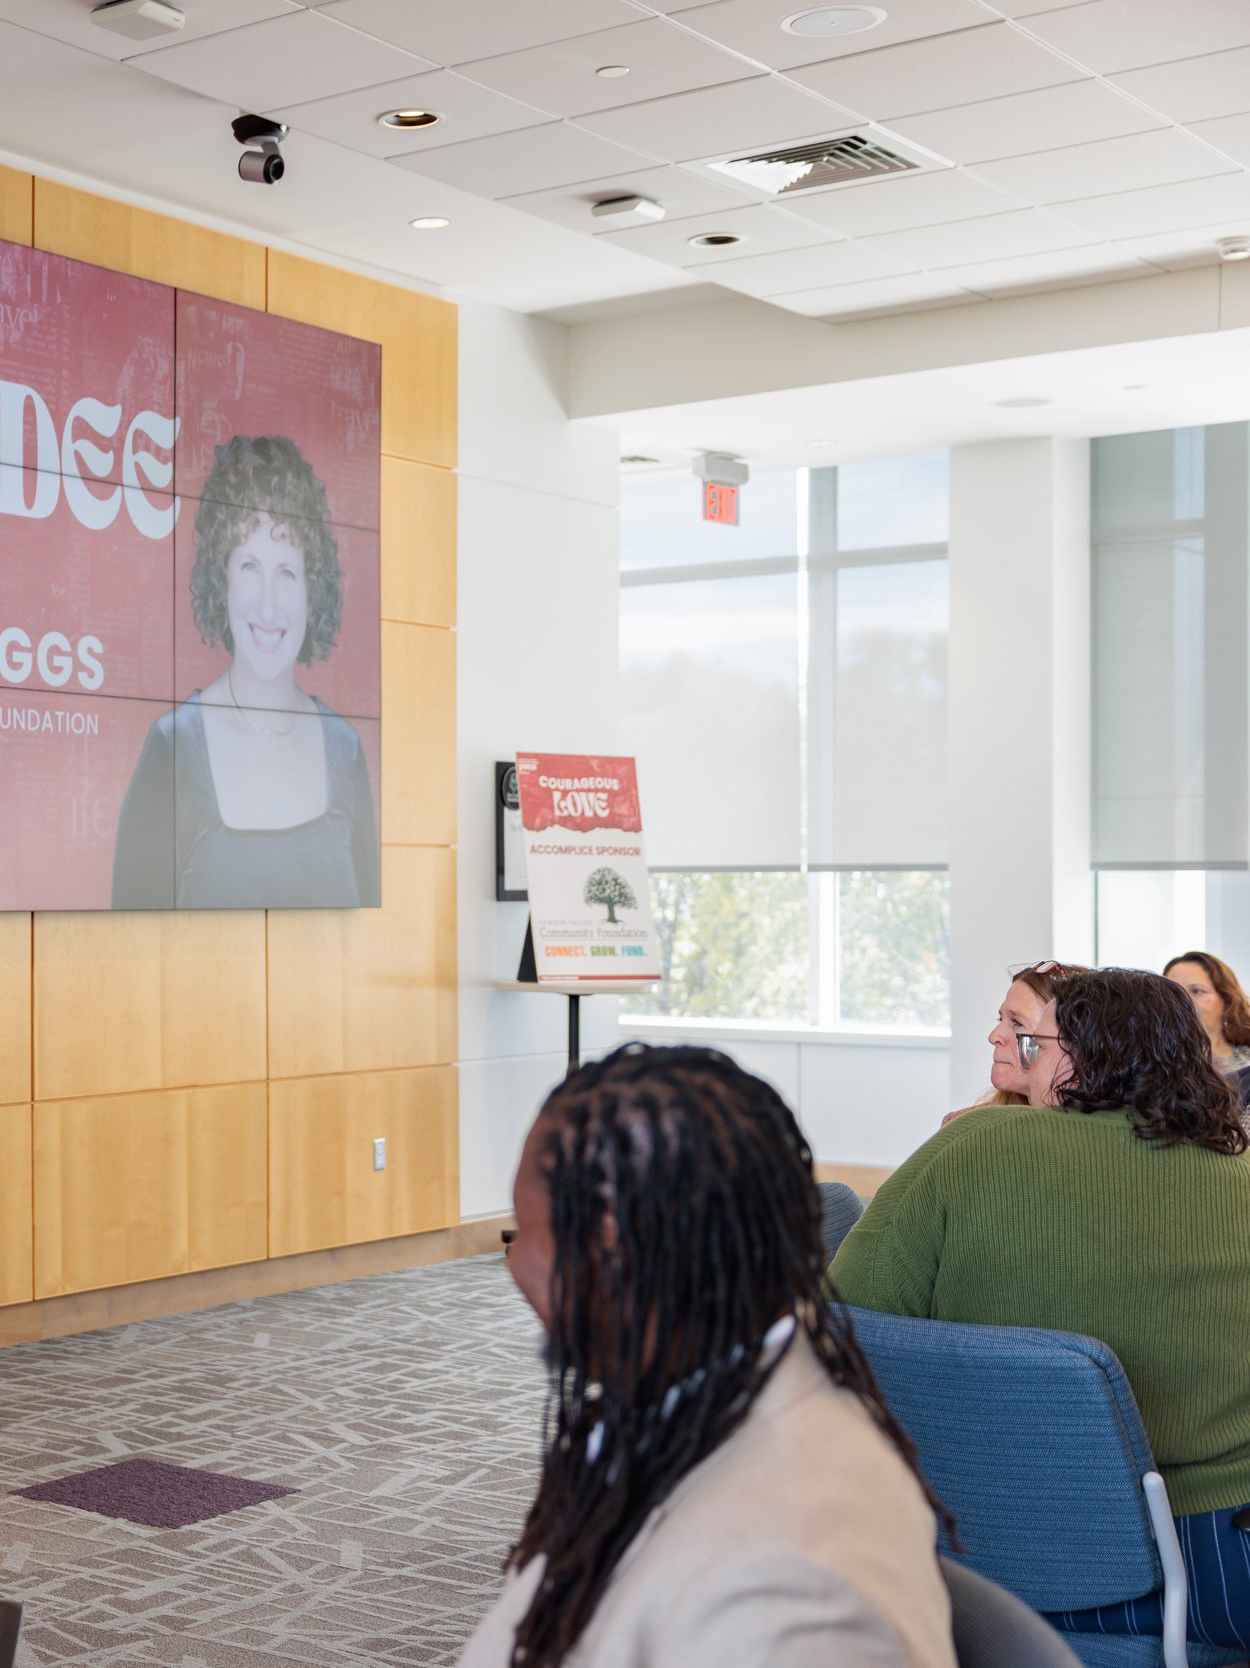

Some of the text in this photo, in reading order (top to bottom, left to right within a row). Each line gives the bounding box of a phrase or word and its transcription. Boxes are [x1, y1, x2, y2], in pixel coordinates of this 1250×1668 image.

[707, 483, 737, 525] EXIT
[538, 775, 620, 791] COURAGEOUS
[552, 790, 610, 817] LOVE
[538, 927, 593, 940] Community
